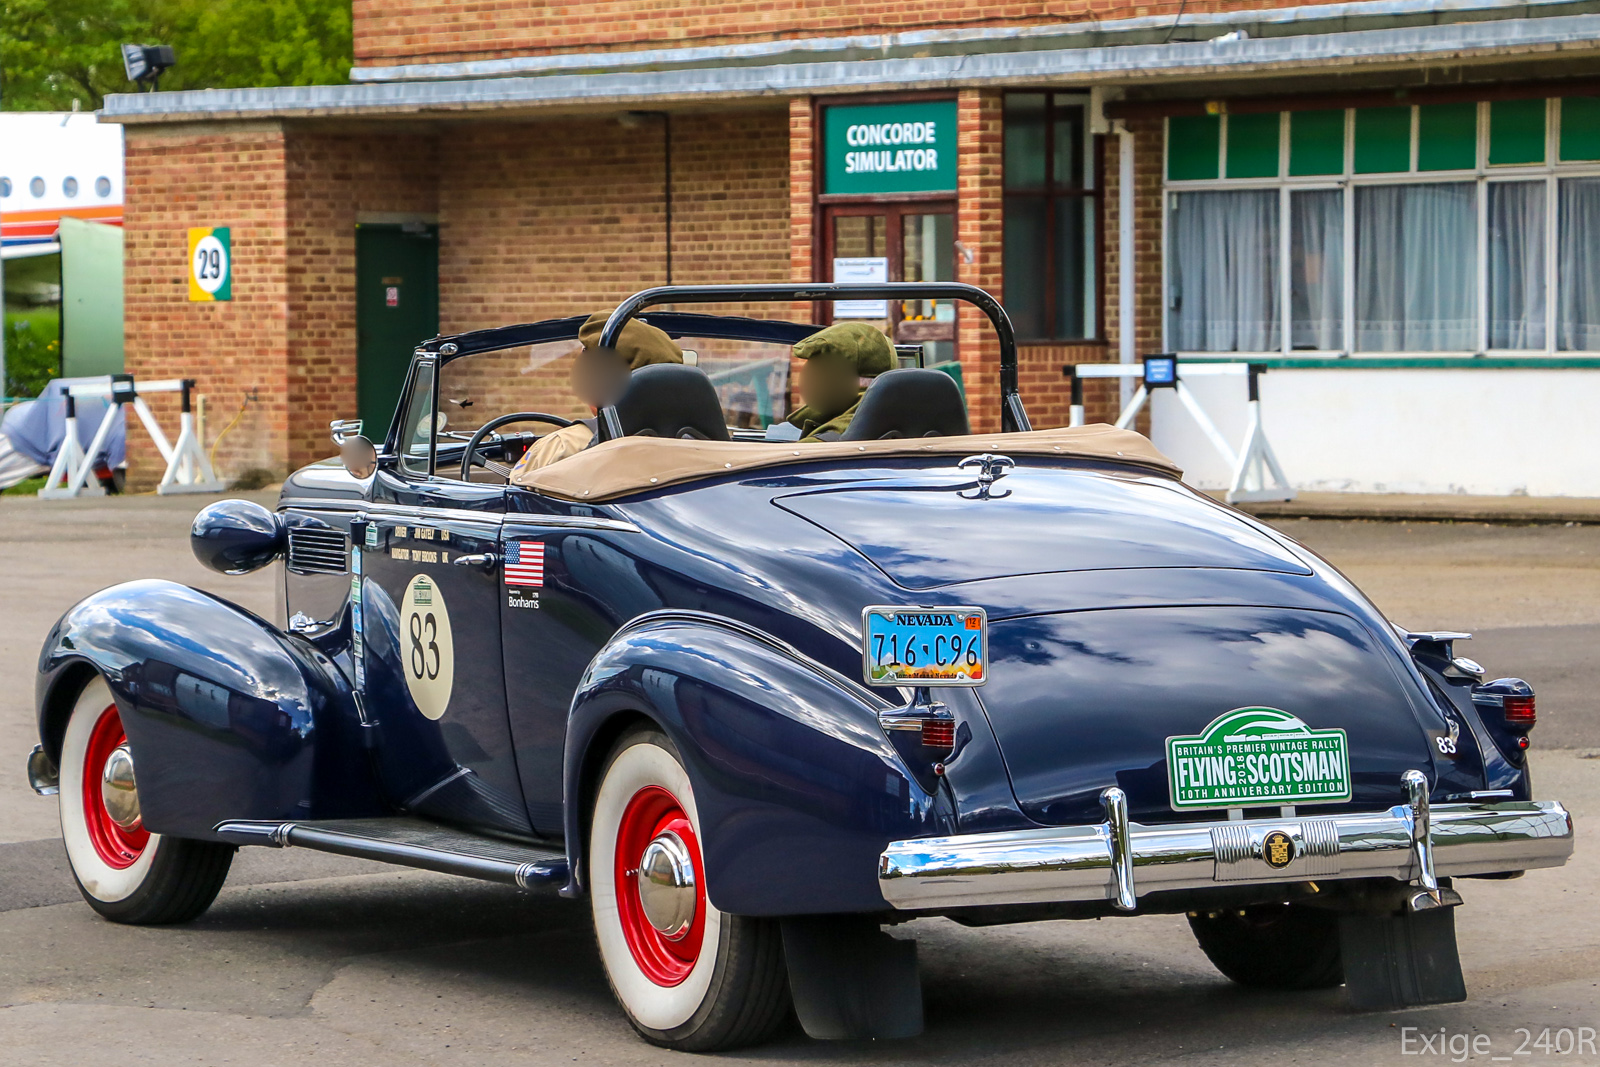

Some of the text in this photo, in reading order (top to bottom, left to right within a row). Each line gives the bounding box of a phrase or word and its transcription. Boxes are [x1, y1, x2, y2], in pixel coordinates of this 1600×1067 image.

[846, 122, 936, 147] CONCORDE
[845, 149, 938, 174] SIMULATOR
[198, 248, 220, 279] 29
[441, 529, 450, 541] USA
[391, 547, 449, 564] NAVIGATOR TONY BROOKS UK
[508, 595, 540, 609] Bonhams
[896, 614, 953, 626] NEVADA
[969, 617, 976, 625] 12
[410, 612, 440, 680] 83
[1177, 739, 1339, 756] BRITAIN'S PREMIER VINTAGE RALLY
[1436, 736, 1457, 754] 83
[1178, 750, 1342, 788] FLYING SCOTSMAN
[1237, 755, 1247, 785] 2018
[1180, 782, 1343, 799] 10TH ANNIVERSARY EDITION
